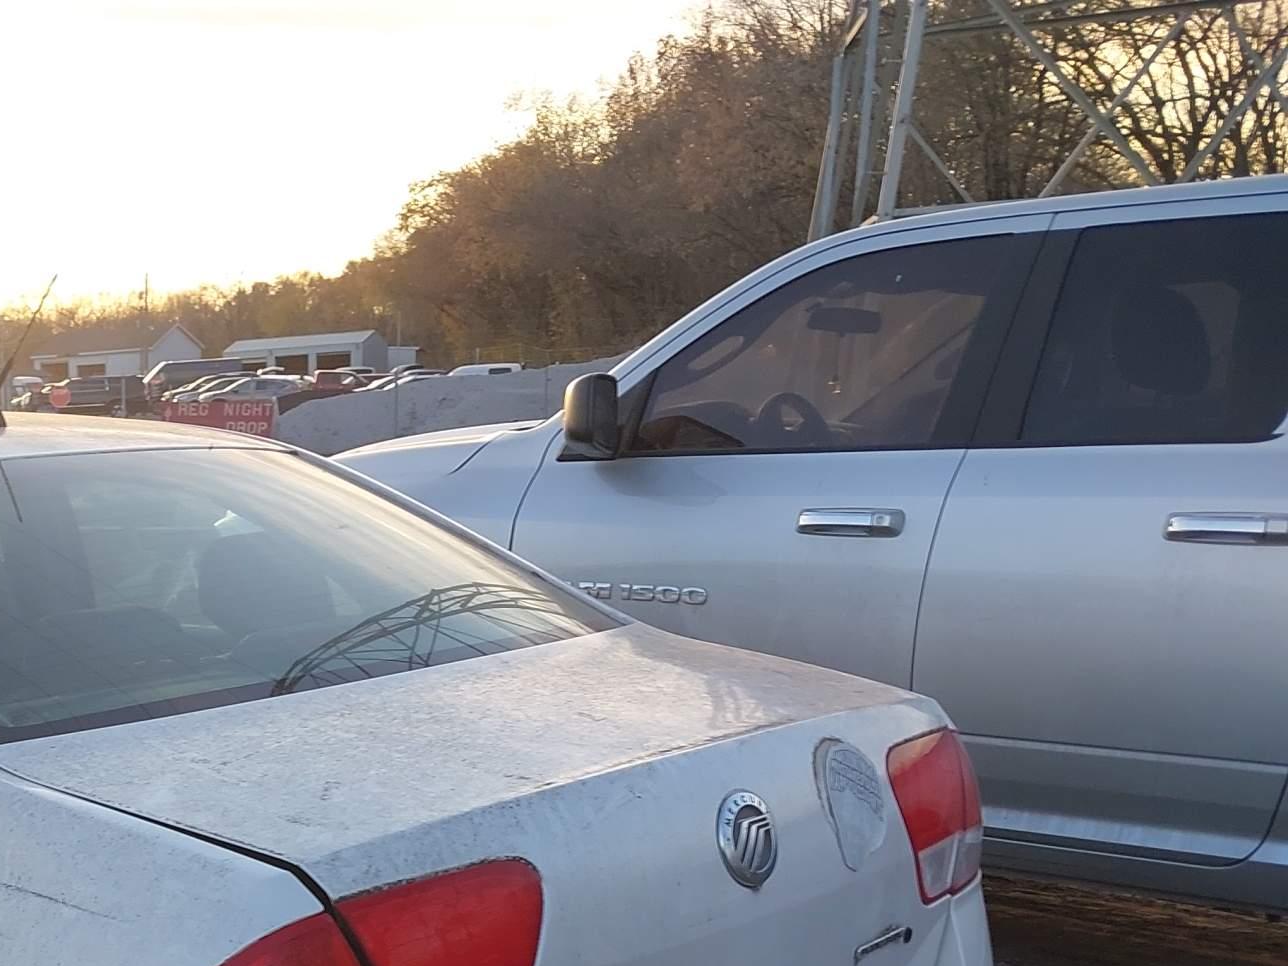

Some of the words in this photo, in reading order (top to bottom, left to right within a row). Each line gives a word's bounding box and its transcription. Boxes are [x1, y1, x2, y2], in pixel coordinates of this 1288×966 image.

[224, 402, 273, 417] NIGHT
[226, 421, 269, 434] DROP
[619, 583, 708, 606] 1500
